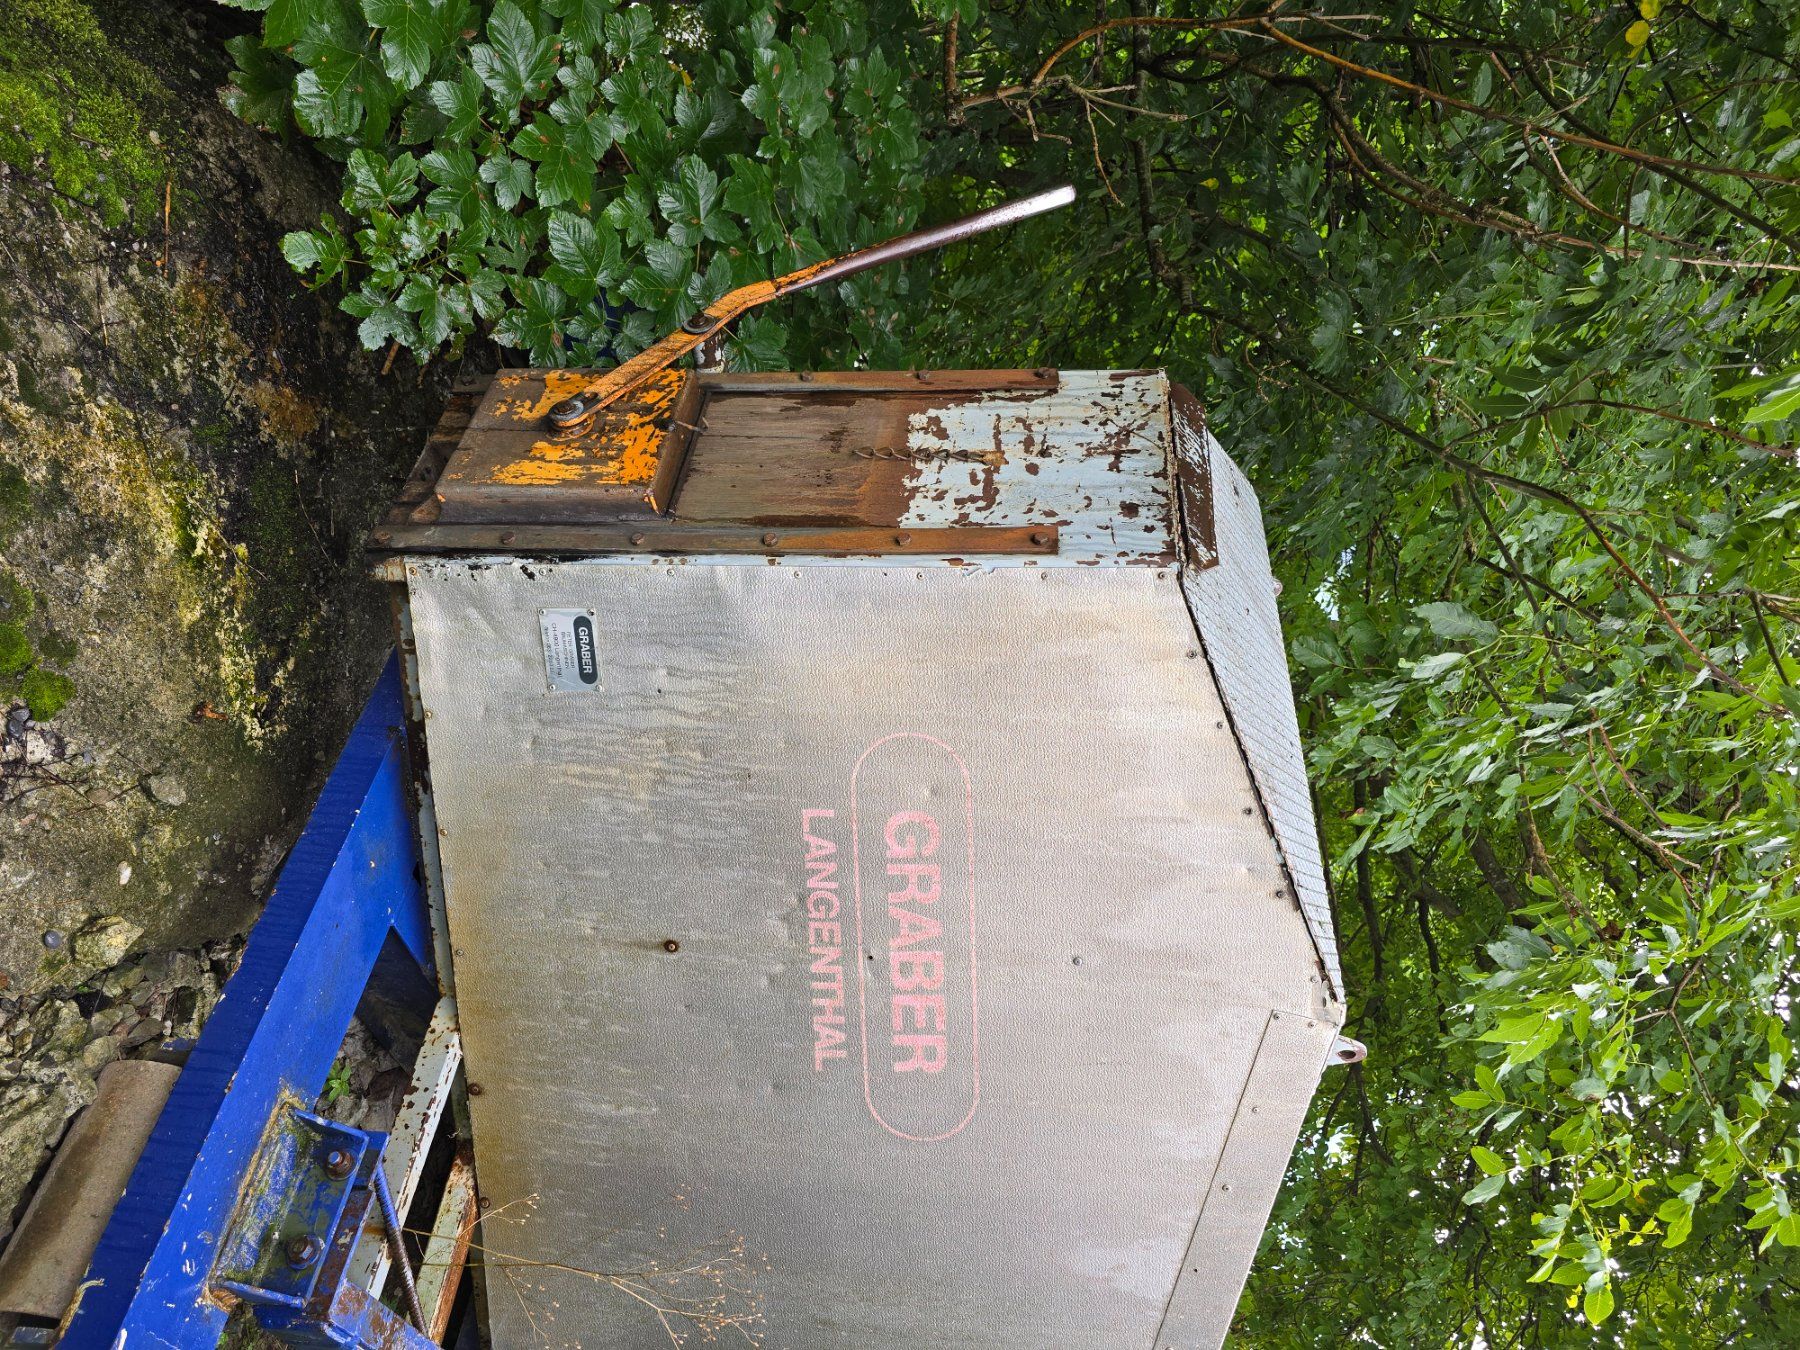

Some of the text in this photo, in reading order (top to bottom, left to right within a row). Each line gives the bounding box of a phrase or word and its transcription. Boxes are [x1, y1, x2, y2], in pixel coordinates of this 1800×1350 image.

[578, 627, 592, 673] GRABER
[801, 808, 847, 1072] LANGENTHAL
[883, 809, 948, 1073] GRABER
